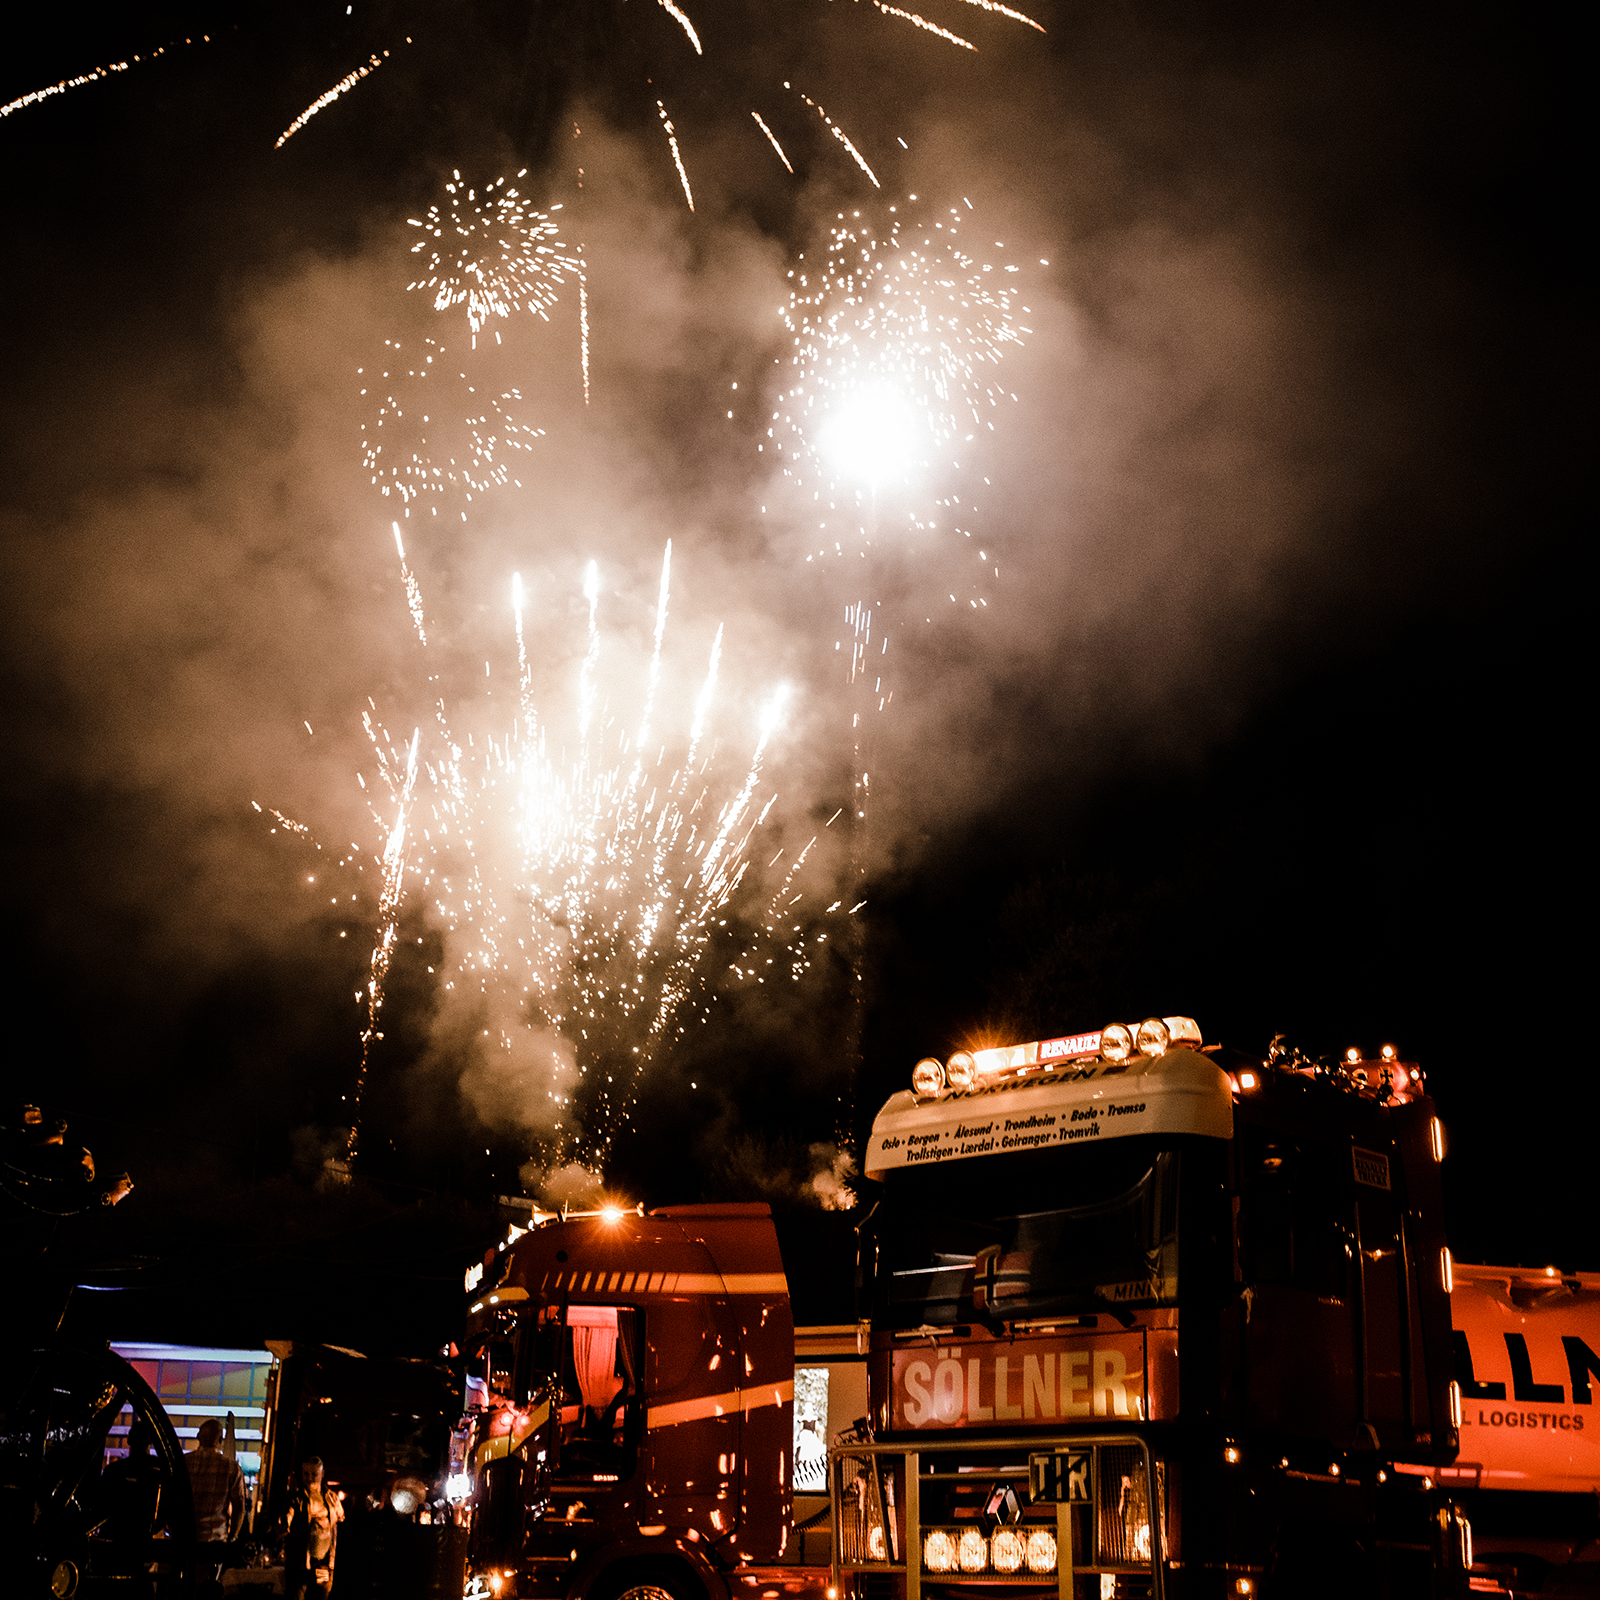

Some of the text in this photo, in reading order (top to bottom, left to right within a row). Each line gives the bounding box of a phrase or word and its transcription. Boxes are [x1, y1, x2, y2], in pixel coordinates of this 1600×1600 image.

[1040, 1034, 1101, 1059] RENAULT
[906, 1122, 1100, 1161] Trollstigen Lærdal Geiranger Tromvik
[907, 1133, 940, 1146] Bergen
[953, 1121, 994, 1139] Ålesund
[1004, 1113, 1056, 1131] Trondheim
[903, 1347, 1130, 1426] SÖLLNER
[1479, 1410, 1584, 1431] LOGISTICS
[1034, 1455, 1088, 1500] TIR
